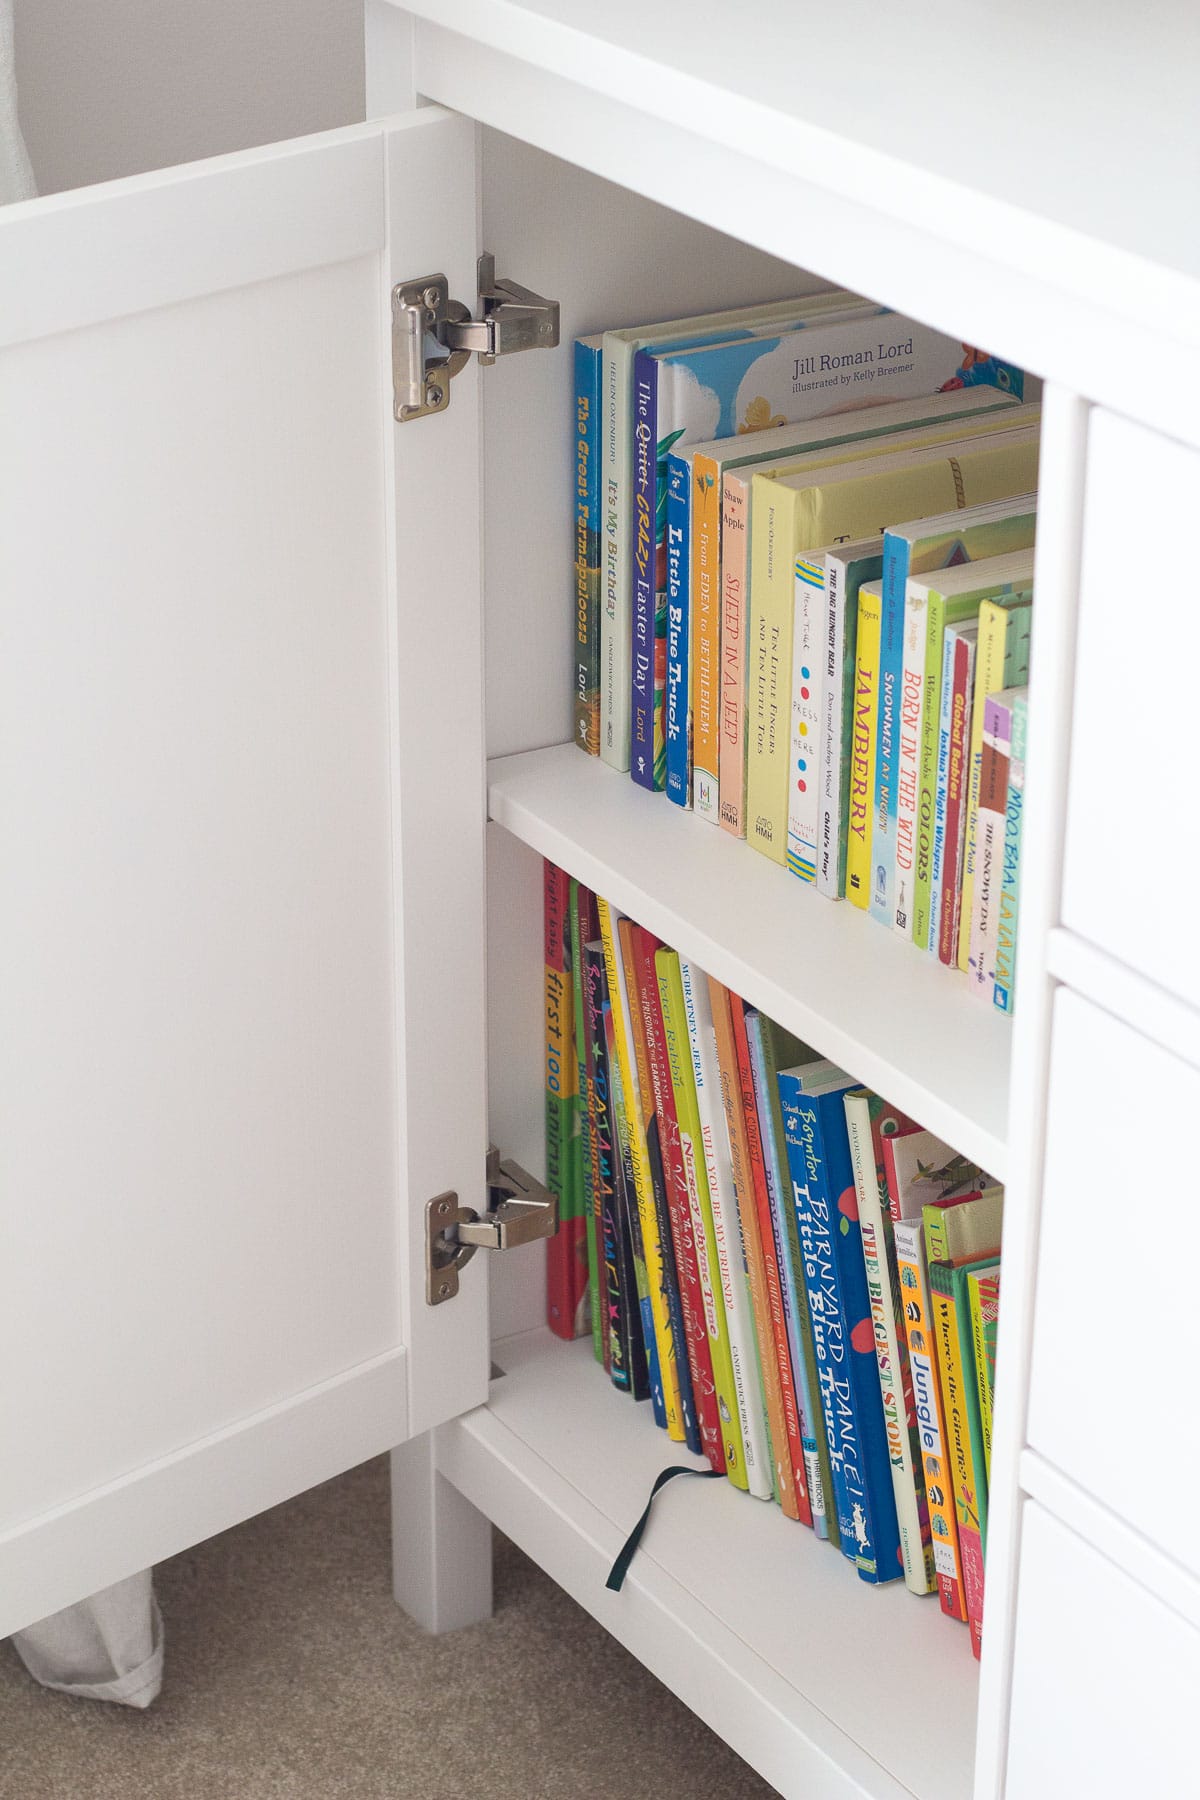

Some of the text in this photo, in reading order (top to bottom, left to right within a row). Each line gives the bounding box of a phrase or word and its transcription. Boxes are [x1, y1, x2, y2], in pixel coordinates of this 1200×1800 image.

[792, 338, 913, 380] Jill Roman Lord
[792, 363, 914, 393] illustrated by Kelly Breemer
[606, 510, 619, 537] My
[632, 382, 652, 696] The Quiet CRAZY Easter Day
[723, 489, 743, 505] Shaw
[723, 513, 745, 531] Apple
[575, 396, 590, 702] The Great Farmapalooza Lord
[606, 540, 618, 620] Birthday
[668, 524, 683, 740] Little Blue Truck
[700, 533, 710, 732] From EDEN to BETHLEHEM
[723, 573, 740, 745] SHEEP IN A JEEP
[827, 568, 837, 677] THE BIG HUNGRY BEAR
[636, 707, 646, 742] Lord
[757, 615, 767, 754] AND TEN LITTLE TOES
[768, 626, 780, 755] TEN LITTLE FINGERS
[825, 691, 835, 799] Don and Audrey Wood
[851, 657, 872, 840] JAMBERRY
[879, 671, 895, 834] SNOWMEN AT NIGHT
[896, 669, 922, 871] BORN IN THE WILD
[950, 692, 964, 800] Global Babies
[721, 809, 739, 827] HMH
[755, 824, 773, 842] HMH
[918, 787, 932, 883] COLORS
[935, 786, 947, 821] Night
[822, 851, 830, 876] Play
[932, 825, 944, 881] Whispers
[979, 822, 994, 935] THE SNOWY DAY
[548, 921, 560, 958] baby
[928, 891, 938, 952] Orchard Books
[998, 923, 1013, 947] LA
[1000, 891, 1016, 918] LA
[586, 963, 604, 1031] Boynton
[658, 977, 684, 1088] Peter Rabbit
[548, 972, 565, 1195] first 100 animals
[692, 1046, 704, 1087] JERAM
[578, 1061, 594, 1217] Bear Wants More
[586, 1078, 602, 1217] Bear Snores On
[627, 1120, 635, 1147] THE
[741, 1067, 750, 1085] THE
[747, 1116, 760, 1164] CONTEST
[798, 1109, 822, 1182] Boynton
[669, 1206, 679, 1223] BOB
[672, 1226, 685, 1273] HARTMAN
[682, 1139, 717, 1335] Nursery Rhyme Time
[703, 1125, 734, 1310] WILL YOU BE MY FRIEND?
[765, 1255, 777, 1278] CARL
[778, 1343, 789, 1385] CATALINA
[784, 1390, 797, 1437] ECHEVERRI
[792, 1180, 844, 1472] Little Blue Truck
[810, 1197, 864, 1496] BARNYARD DANCE!
[861, 1222, 905, 1472] THE BIGGEST STORY
[974, 1325, 982, 1359] GARDEN
[732, 1346, 750, 1436] CANDLEWICK PRESS
[913, 1356, 938, 1448] Jungle
[947, 1376, 957, 1403] the
[951, 1407, 967, 1480] Giraffe?
